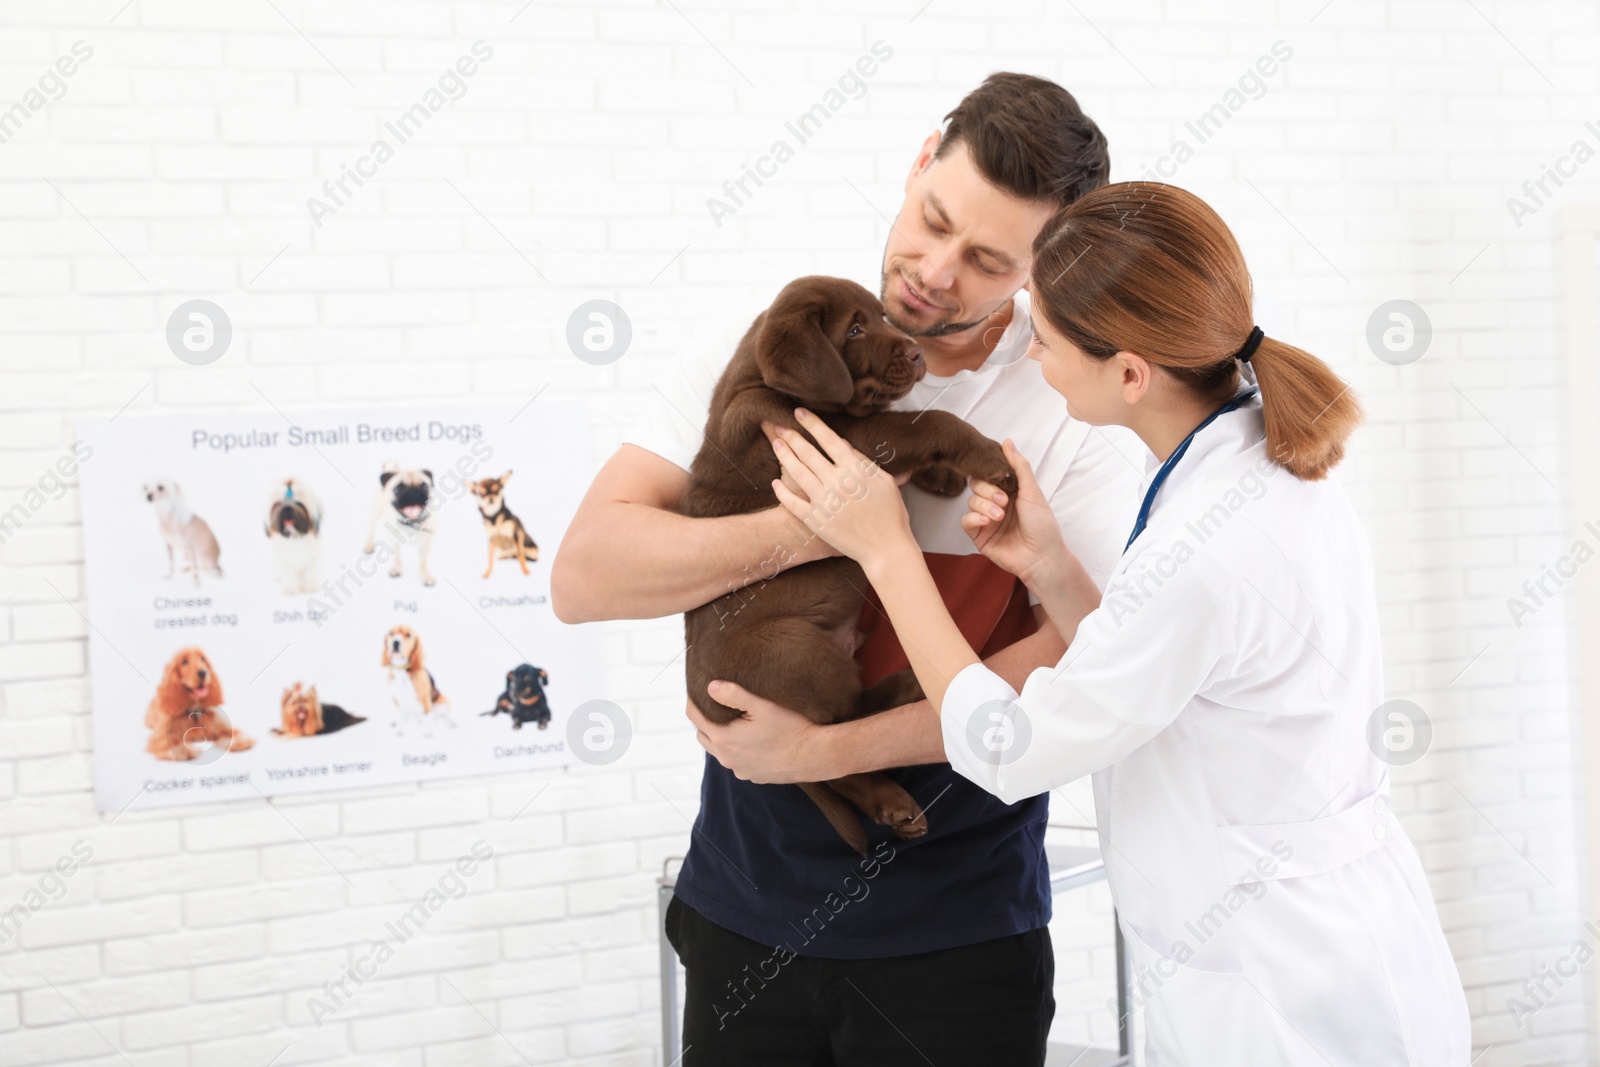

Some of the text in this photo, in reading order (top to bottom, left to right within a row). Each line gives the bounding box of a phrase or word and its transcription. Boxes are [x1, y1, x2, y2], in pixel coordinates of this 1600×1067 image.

[191, 421, 482, 453] Popular Small Breed Dogs
[153, 597, 212, 610] Chinese
[394, 600, 418, 613] Pug
[478, 595, 547, 609] Chihuahua
[154, 613, 239, 629] crested dog
[273, 610, 303, 624] Shih
[494, 742, 564, 758] Dachshund
[402, 752, 447, 767] Beagle
[265, 761, 372, 781] Yorkshire terrier
[143, 772, 250, 792] Cocker spaniel
